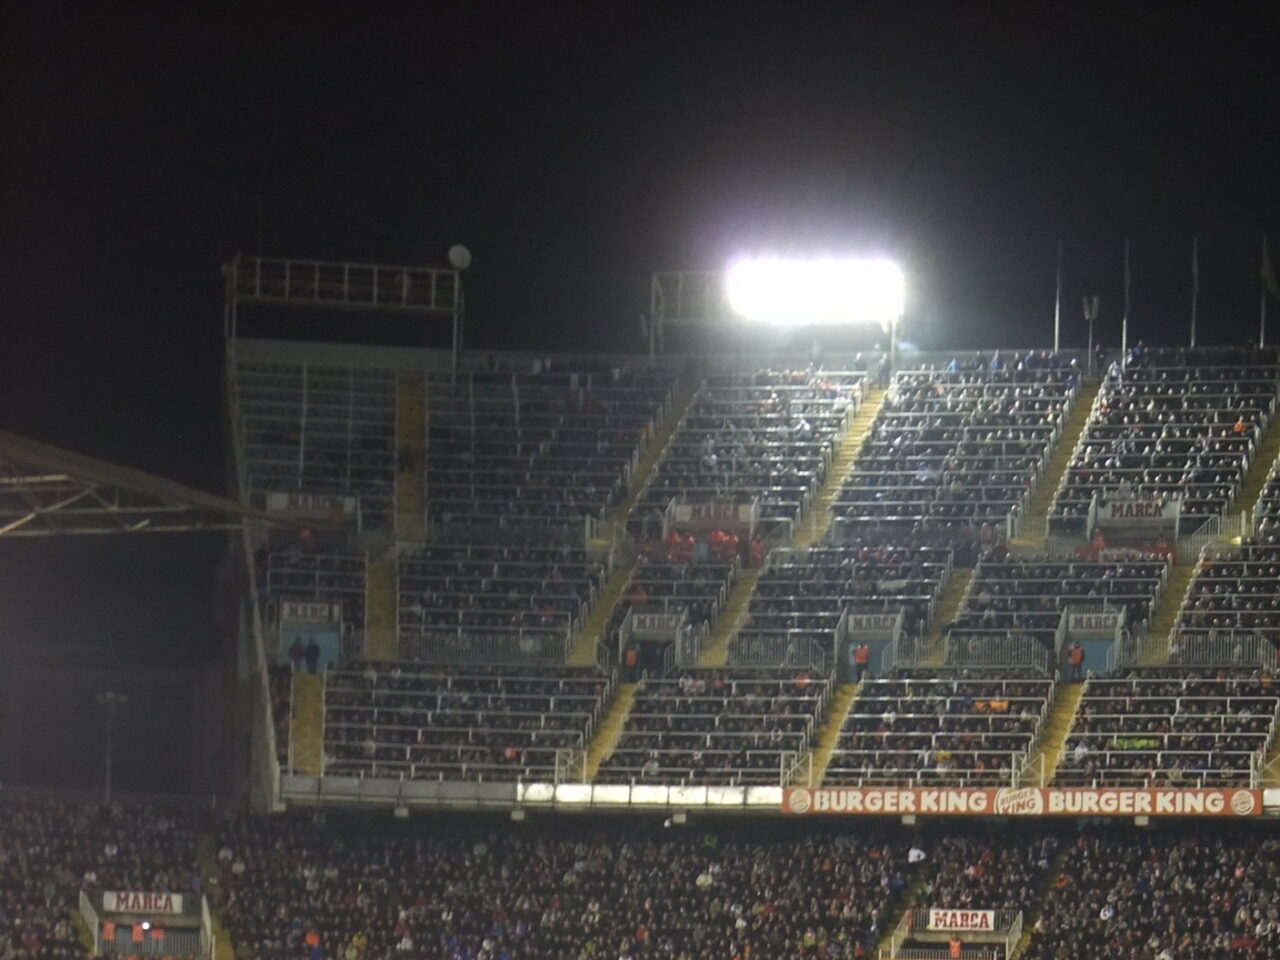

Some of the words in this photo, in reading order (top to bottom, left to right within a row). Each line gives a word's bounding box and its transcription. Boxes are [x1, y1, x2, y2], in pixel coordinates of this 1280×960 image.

[1111, 501, 1164, 519] MARCA
[814, 790, 915, 811] BURGER
[921, 790, 987, 811] KING
[1001, 799, 1036, 815] KING
[1049, 792, 1152, 813] BURGER
[1156, 792, 1225, 812] KING
[116, 891, 174, 910] MARCA
[934, 912, 990, 929] MARCA
